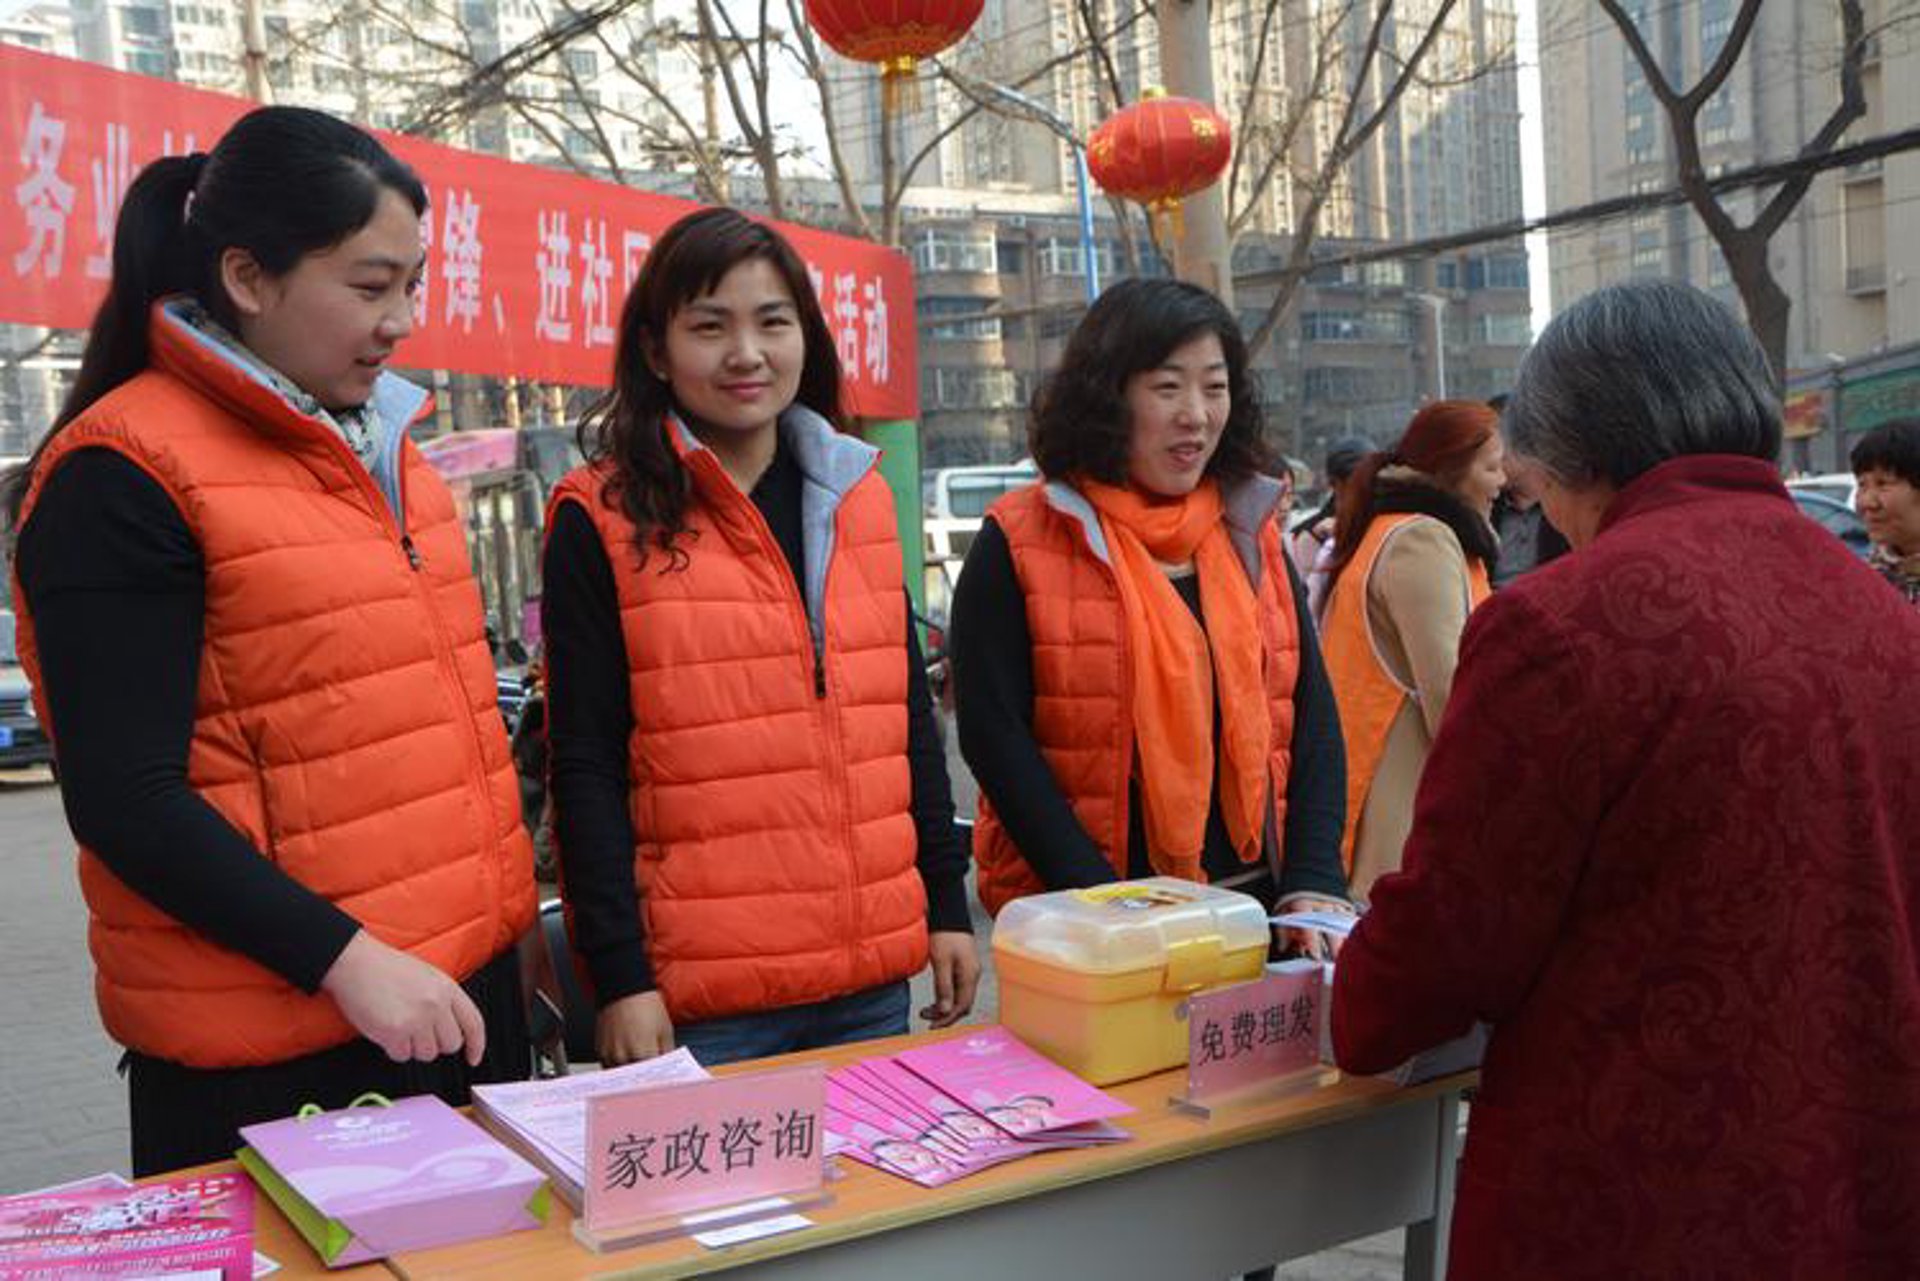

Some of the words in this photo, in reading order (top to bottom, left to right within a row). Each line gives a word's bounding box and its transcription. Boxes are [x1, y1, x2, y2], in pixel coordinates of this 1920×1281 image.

[806, 263, 888, 384] 活动
[1198, 994, 1313, 1066] 免费理发
[603, 1108, 816, 1191] 家政咨询
